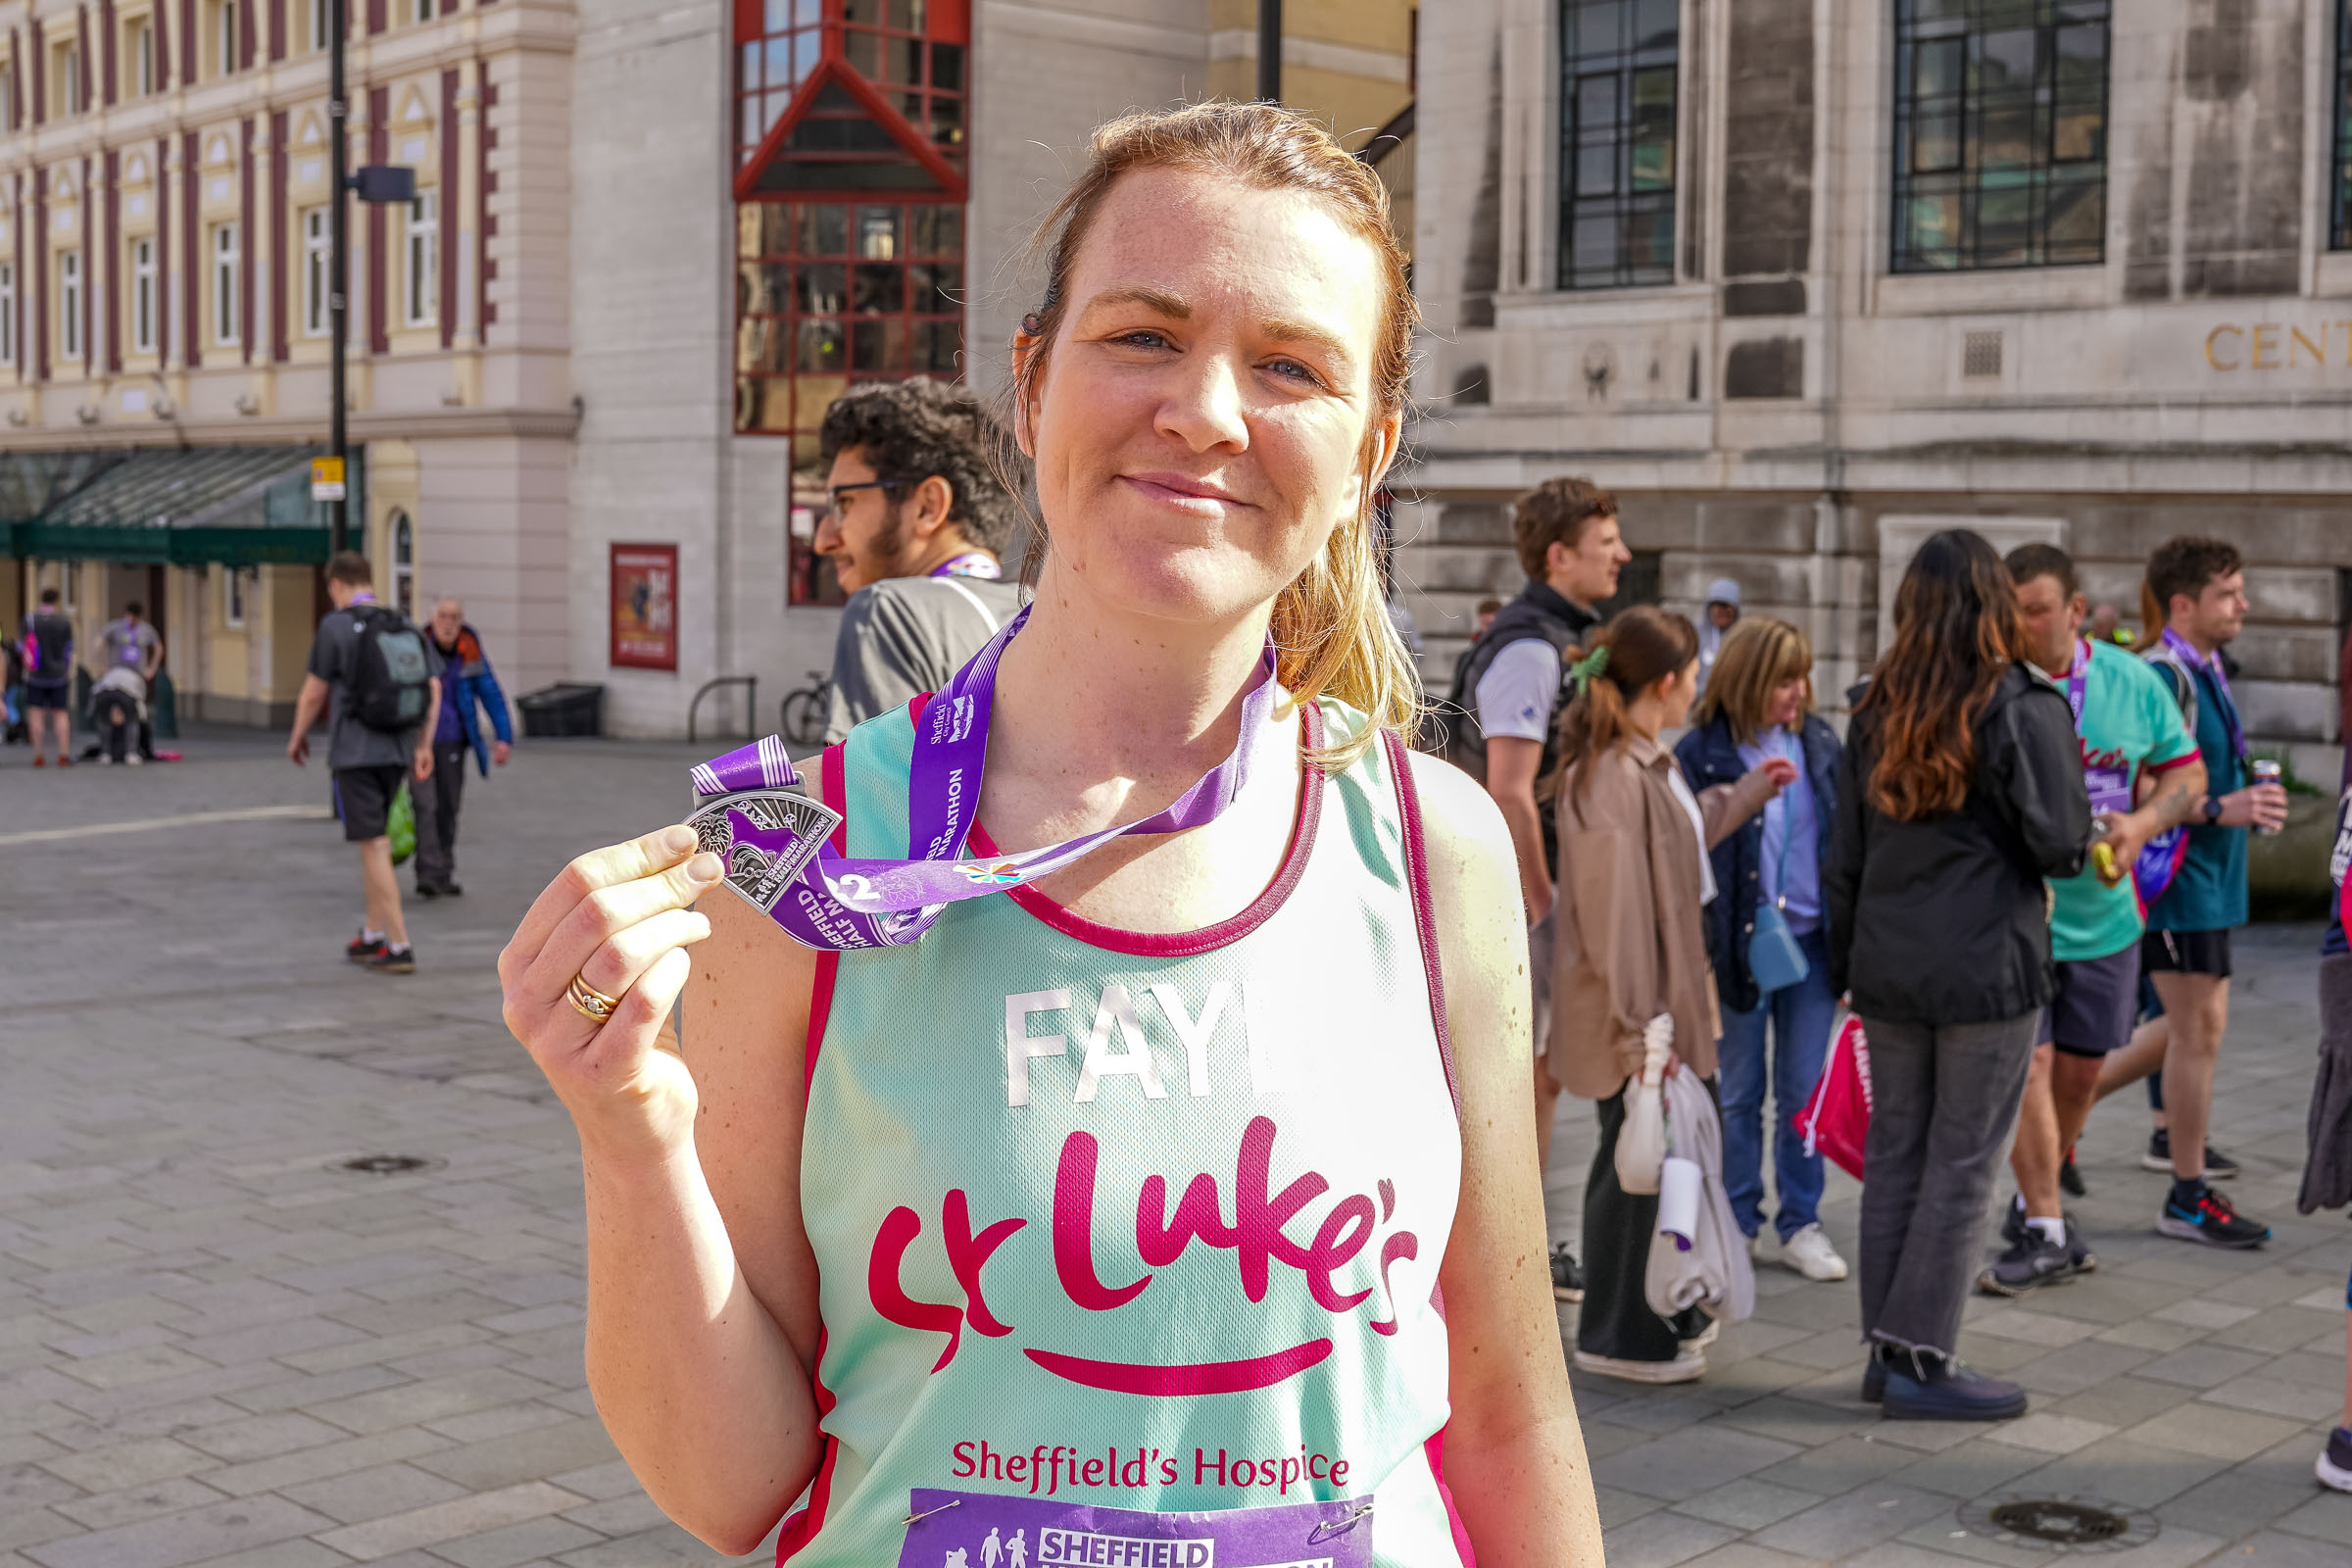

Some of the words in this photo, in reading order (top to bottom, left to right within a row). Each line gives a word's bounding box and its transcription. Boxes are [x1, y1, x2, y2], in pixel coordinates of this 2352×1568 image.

[931, 704, 947, 745] Sheffield
[936, 767, 964, 858] MARATHON
[767, 840, 799, 879] SHEFFIELD
[773, 859, 793, 884] HALF
[789, 816, 831, 866] MARATHON
[838, 872, 882, 901] 2
[798, 889, 858, 950] SHEFFIELD
[834, 917, 873, 950] HALF
[1053, 1114, 1418, 1336] Luke's
[952, 1440, 1178, 1495] Sheffield's
[1195, 1444, 1349, 1495] Hospice
[1042, 1531, 1210, 1568] SHEFFIELD
